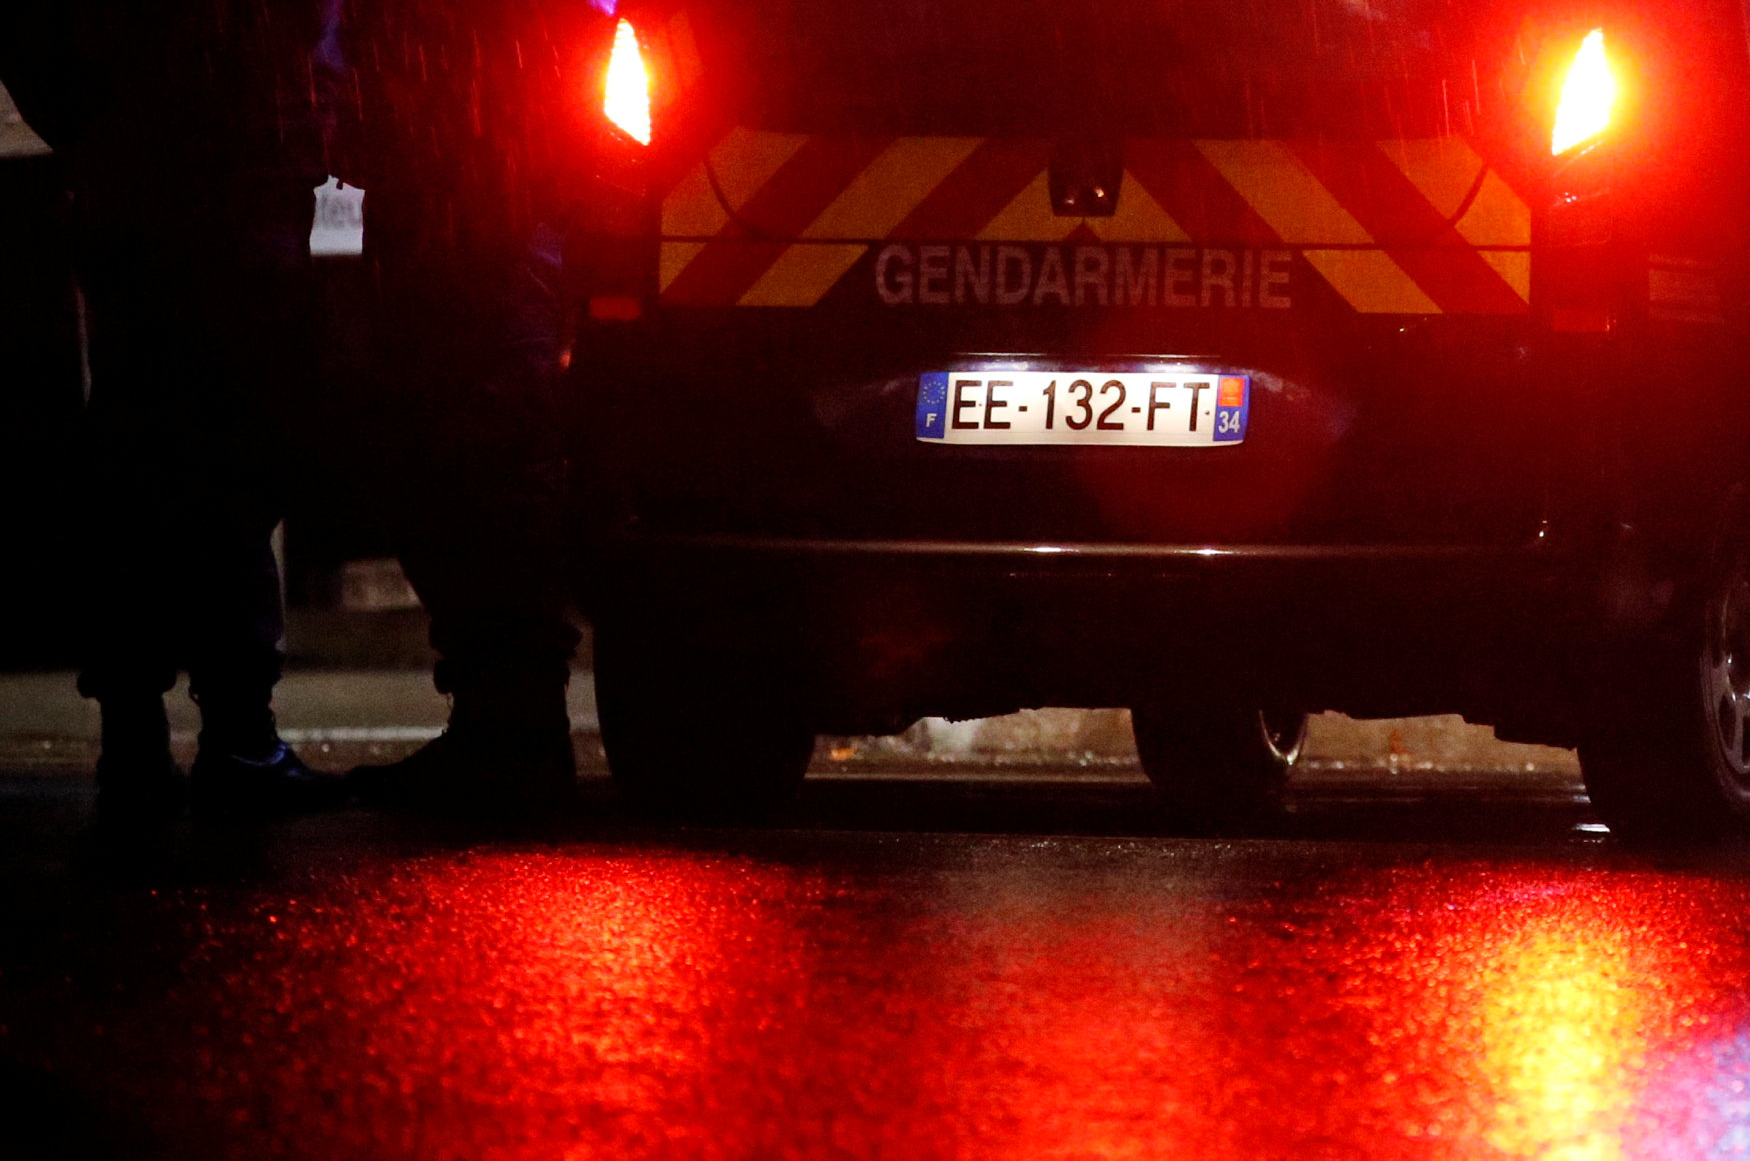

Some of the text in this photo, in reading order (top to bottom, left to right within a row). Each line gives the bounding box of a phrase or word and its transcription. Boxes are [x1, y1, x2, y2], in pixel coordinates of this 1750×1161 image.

[875, 243, 1293, 309] GENDARMERIE
[925, 379, 1241, 434] F EE-132-FT 34
